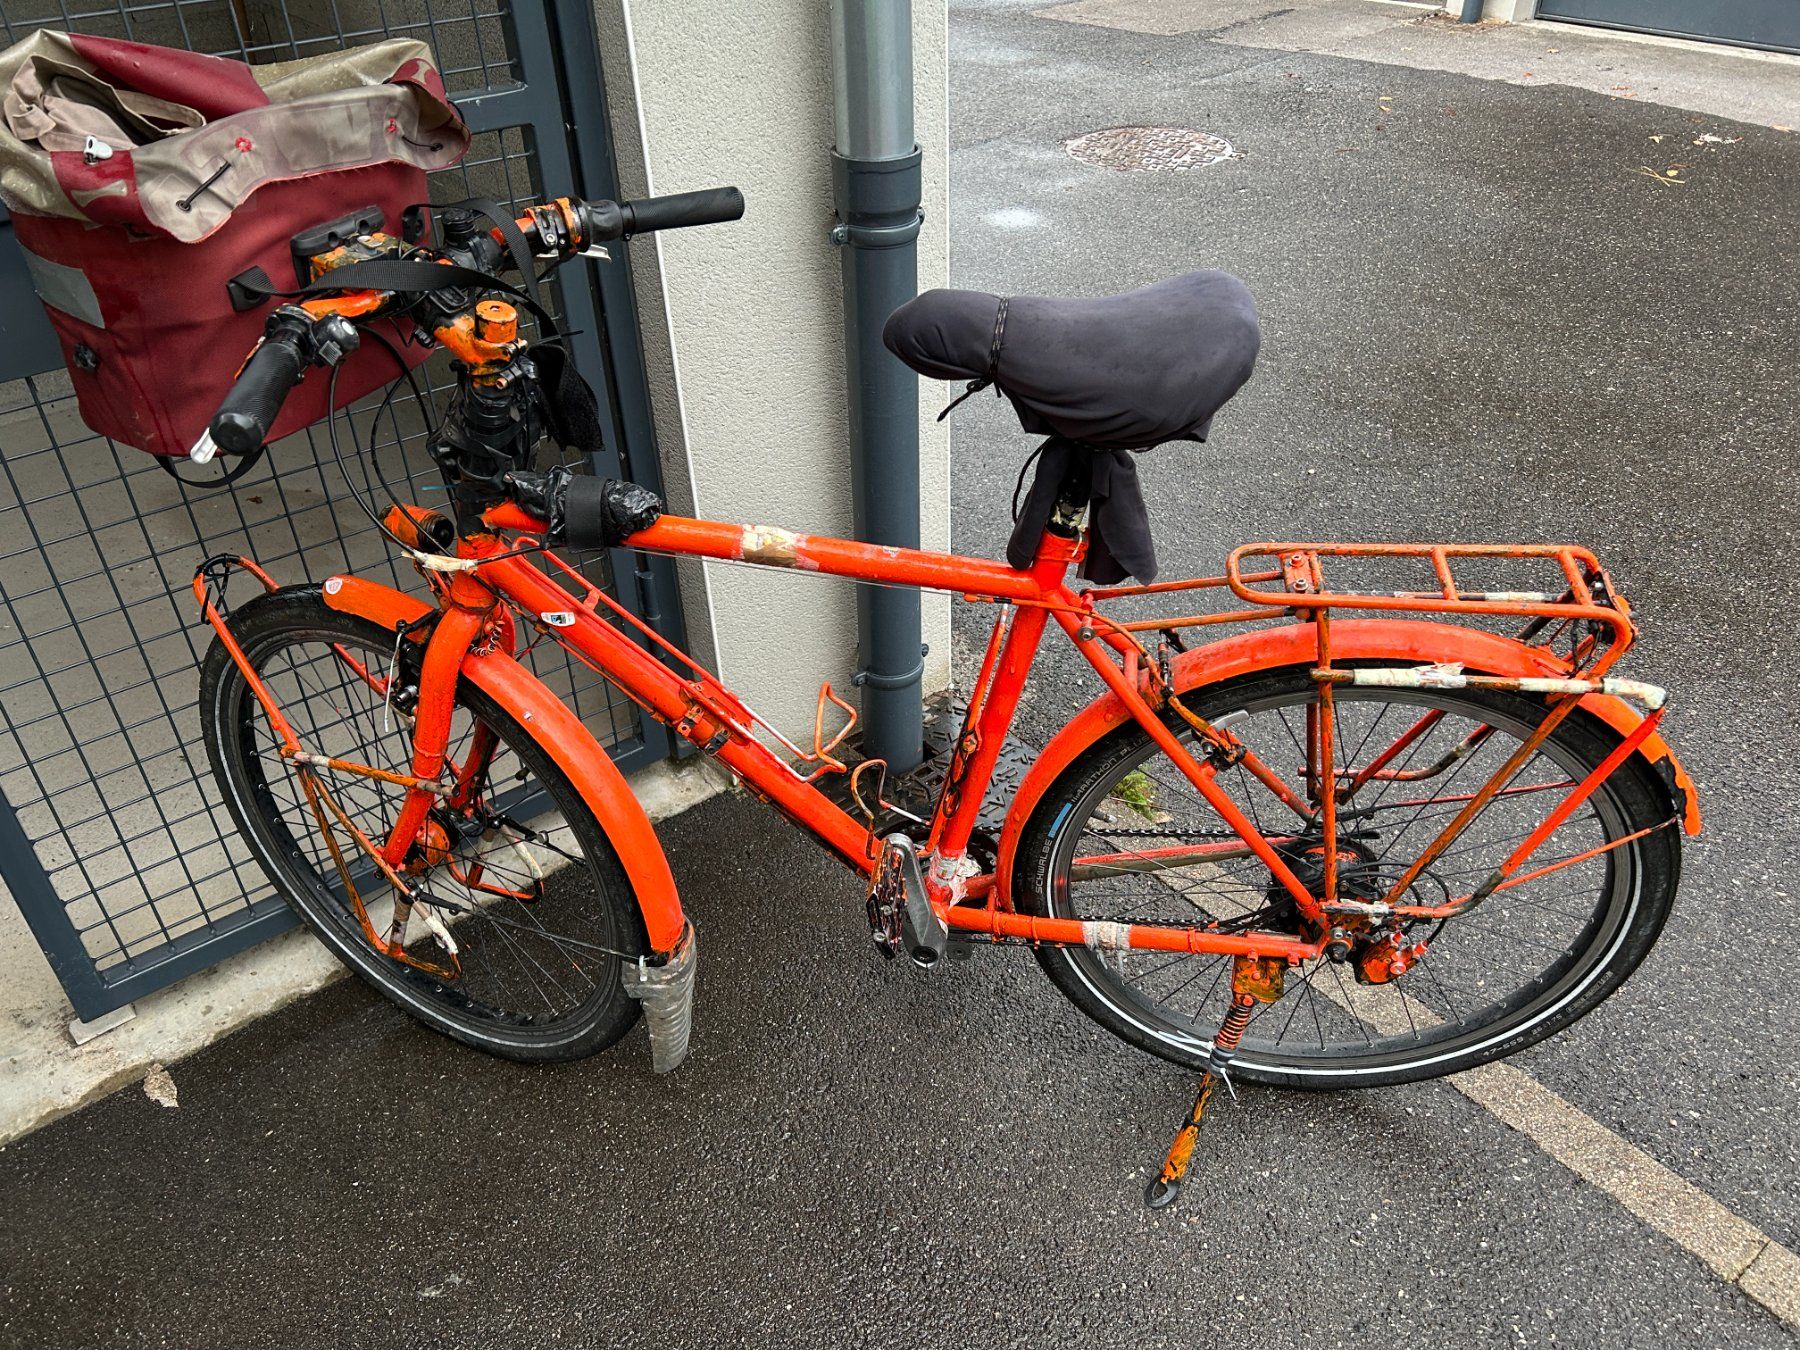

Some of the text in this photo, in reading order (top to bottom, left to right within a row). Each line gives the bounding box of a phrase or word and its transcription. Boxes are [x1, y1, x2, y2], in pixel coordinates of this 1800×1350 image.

[1035, 735, 1150, 895] SCHWALBE MARATHON PLUS
